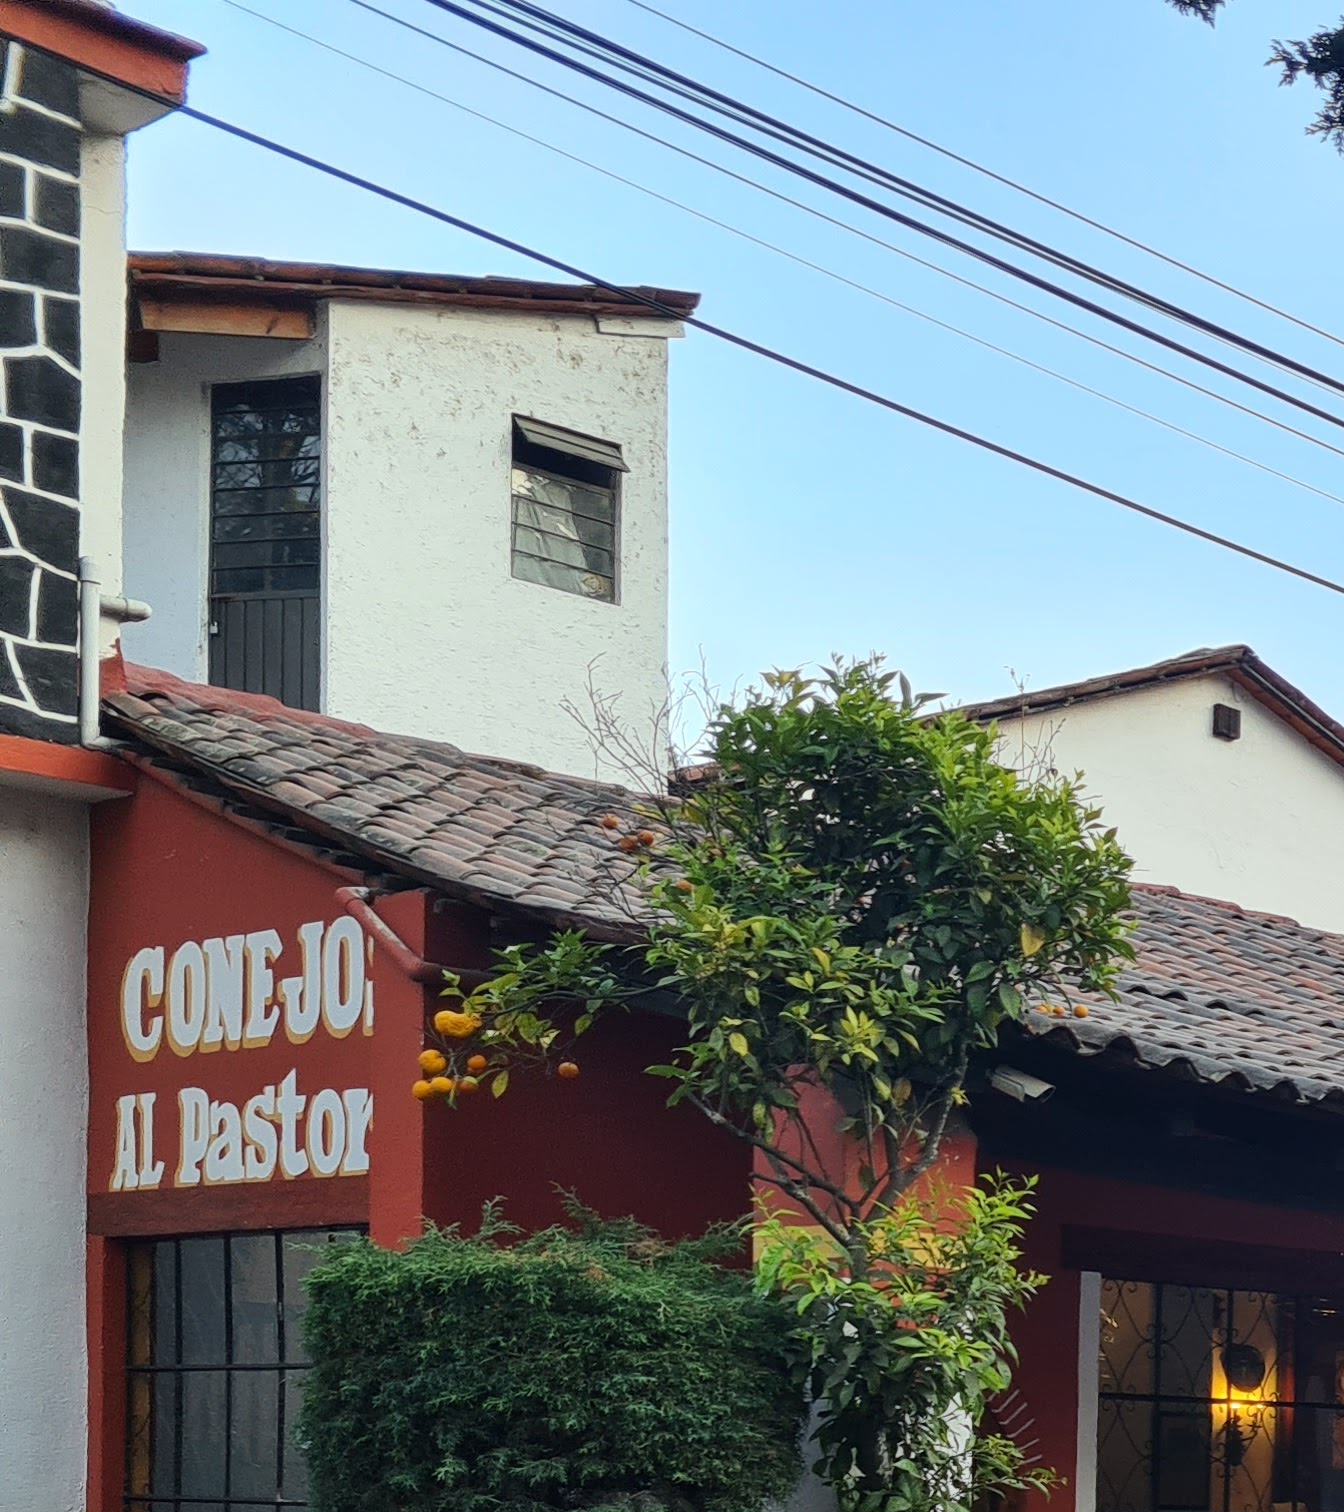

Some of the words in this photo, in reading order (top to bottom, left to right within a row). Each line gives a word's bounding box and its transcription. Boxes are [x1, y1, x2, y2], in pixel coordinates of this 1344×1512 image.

[121, 915, 374, 1062] CONEJO
[109, 1092, 165, 1191] AL
[175, 1068, 374, 1187] Pastor
